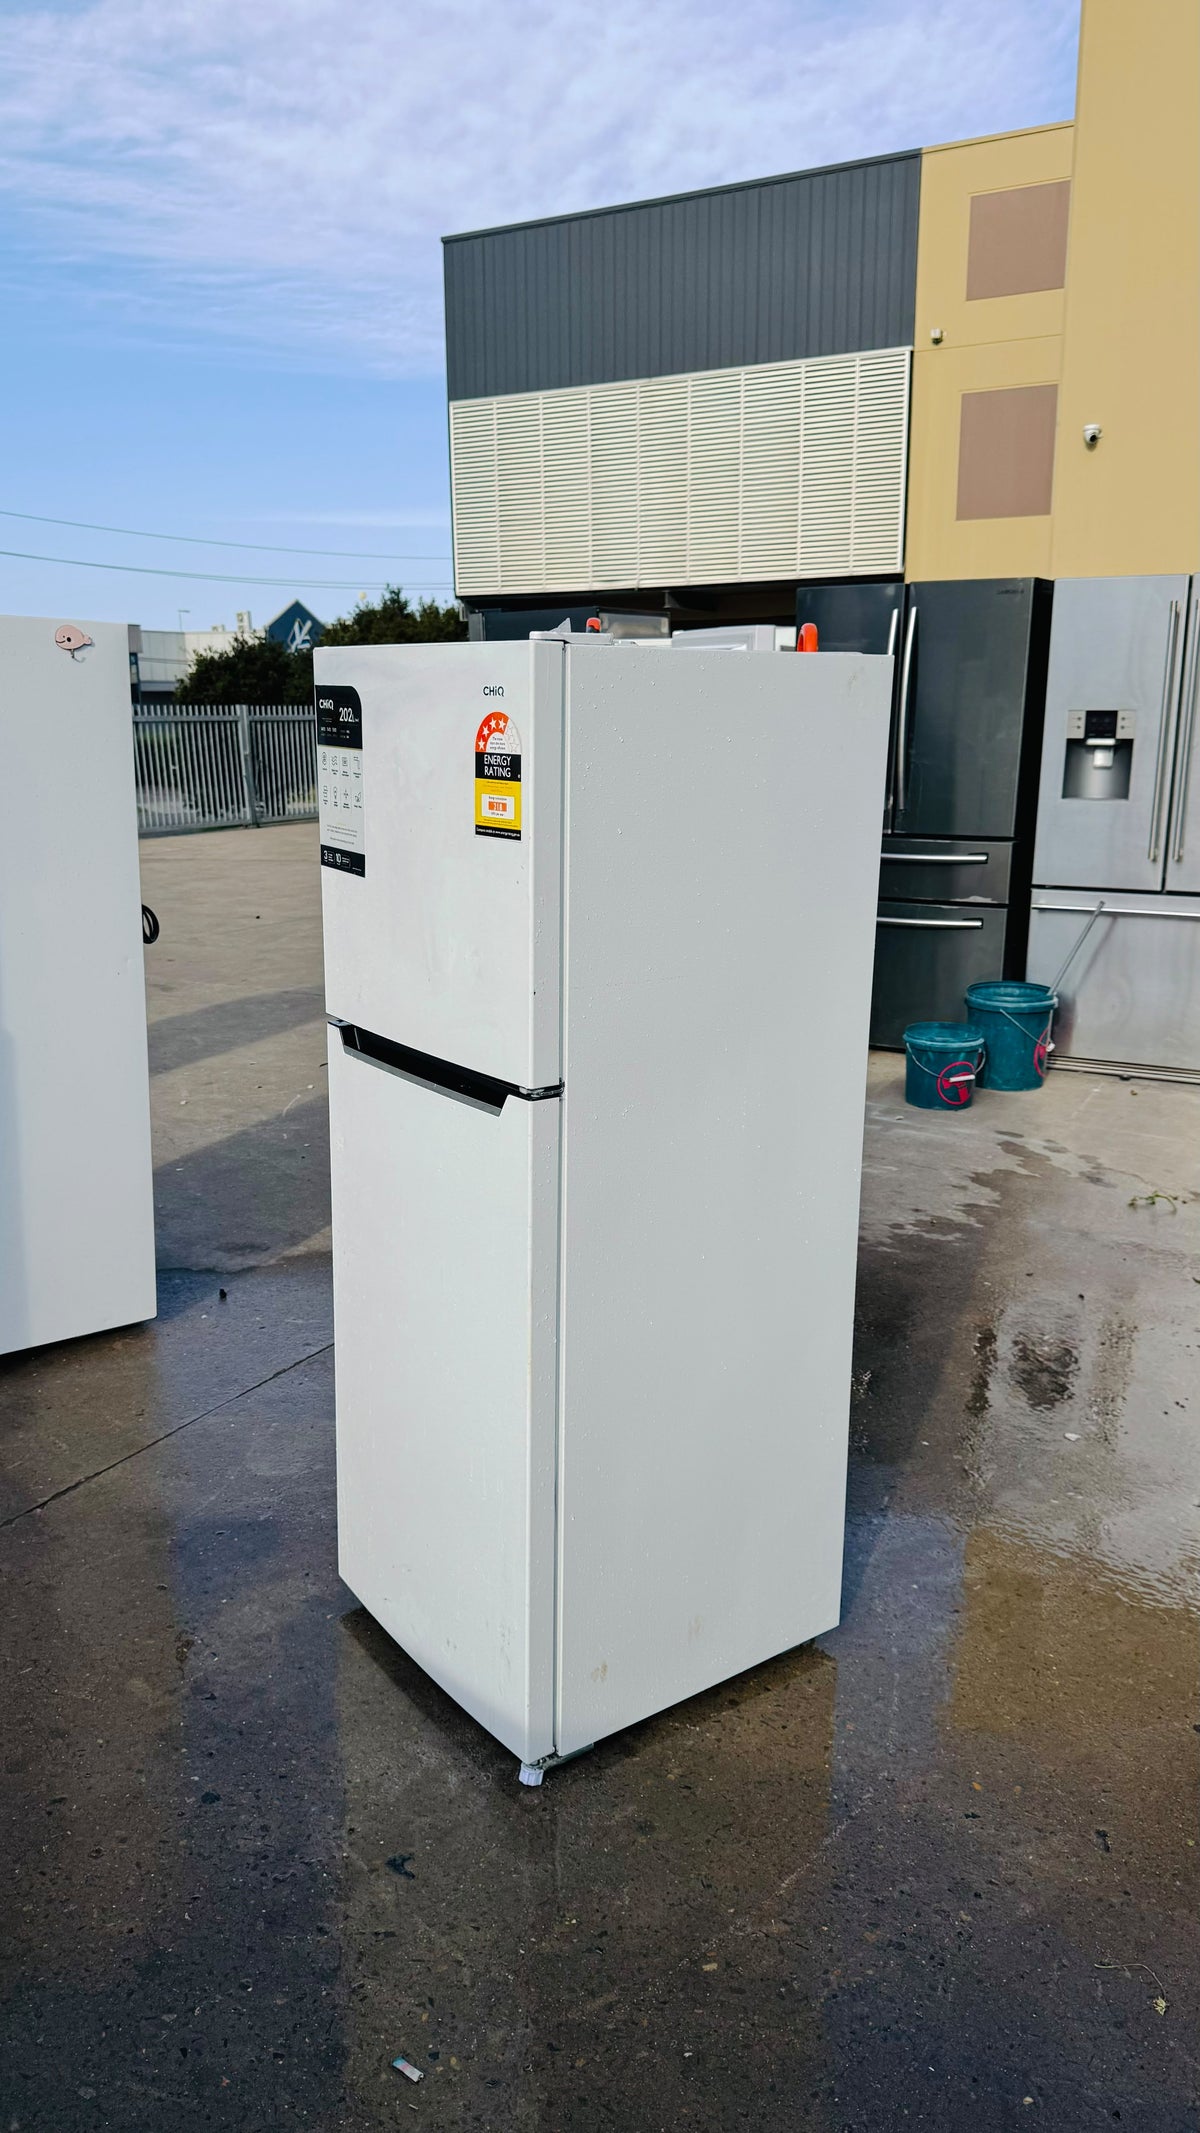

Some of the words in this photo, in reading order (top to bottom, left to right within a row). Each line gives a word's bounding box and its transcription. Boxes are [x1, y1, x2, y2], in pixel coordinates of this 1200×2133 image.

[483, 686, 504, 697] CHiQ
[484, 754, 511, 766] ENERGY
[484, 766, 511, 778] RATING
